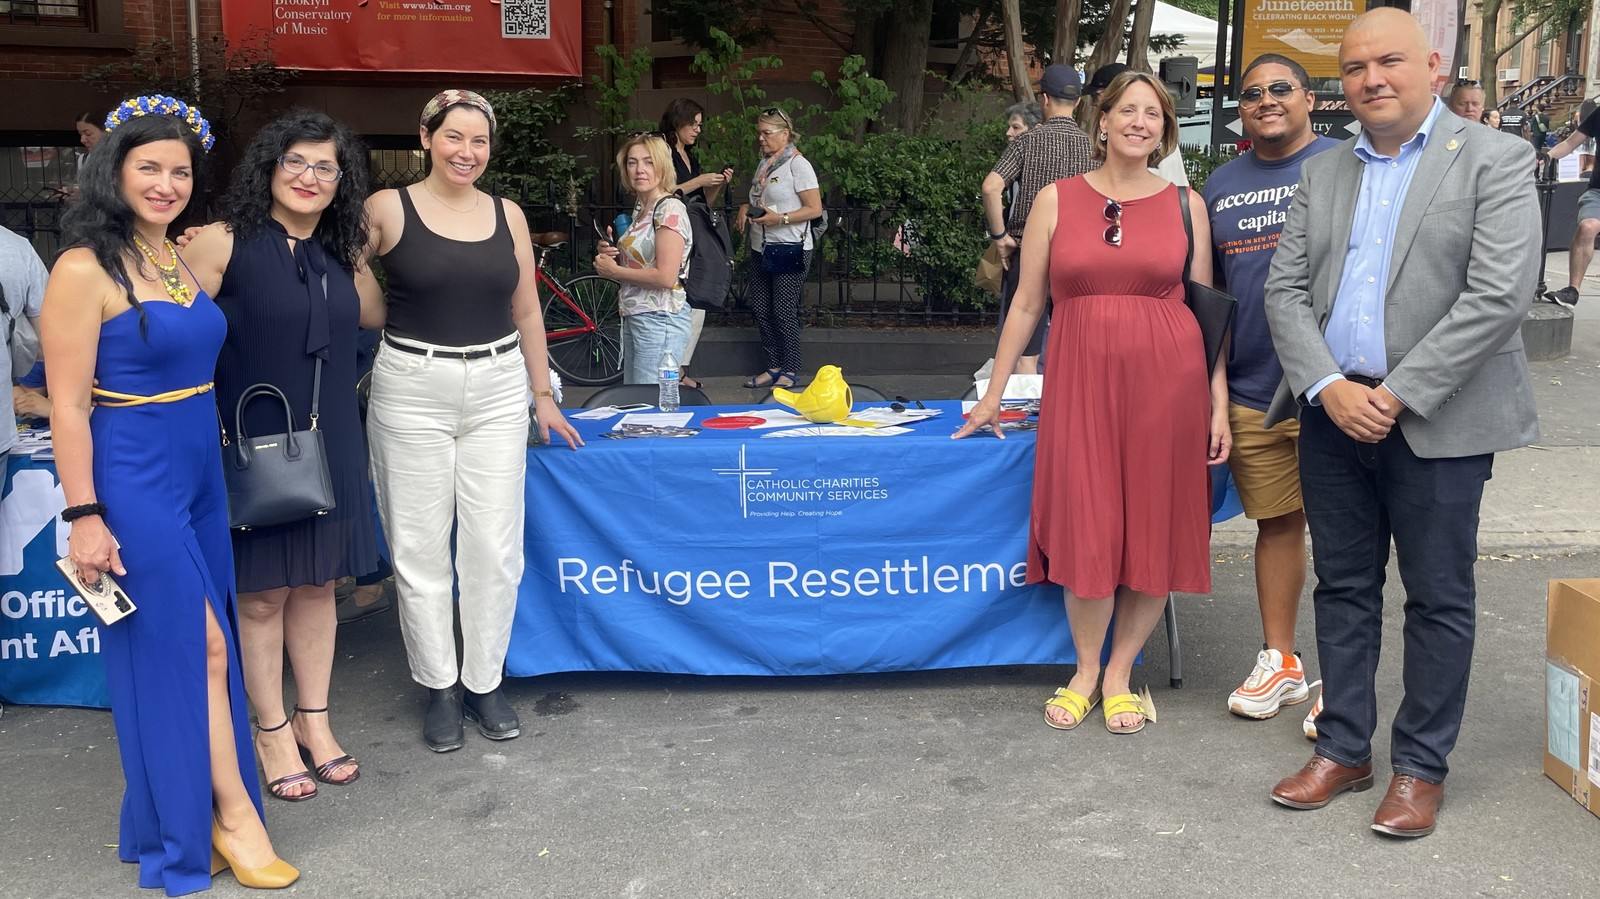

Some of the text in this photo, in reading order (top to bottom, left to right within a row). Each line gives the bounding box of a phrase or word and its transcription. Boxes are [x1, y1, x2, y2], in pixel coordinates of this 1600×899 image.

[380, 1, 472, 12] Visit www.bkcm.org
[1257, 0, 1355, 11] Juneteenth
[275, 7, 352, 24] Conservatory
[377, 12, 391, 21] for
[419, 12, 473, 22] information
[1253, 13, 1357, 21] CELEBRATING BLACK WOMEN
[275, 22, 328, 35] of Music
[1216, 183, 1299, 212] accompa
[1238, 205, 1292, 232] capita
[1253, 235, 1267, 243] NEW
[1268, 232, 1282, 241] YOR
[746, 477, 880, 490] CATHOLIC CHARITIES
[747, 489, 888, 502] COMMUNITY SERVICES
[798, 510, 824, 518] Creating
[557, 555, 1028, 605] Refugee Resettleme
[1, 589, 88, 619] Offic
[1, 632, 39, 660] nt
